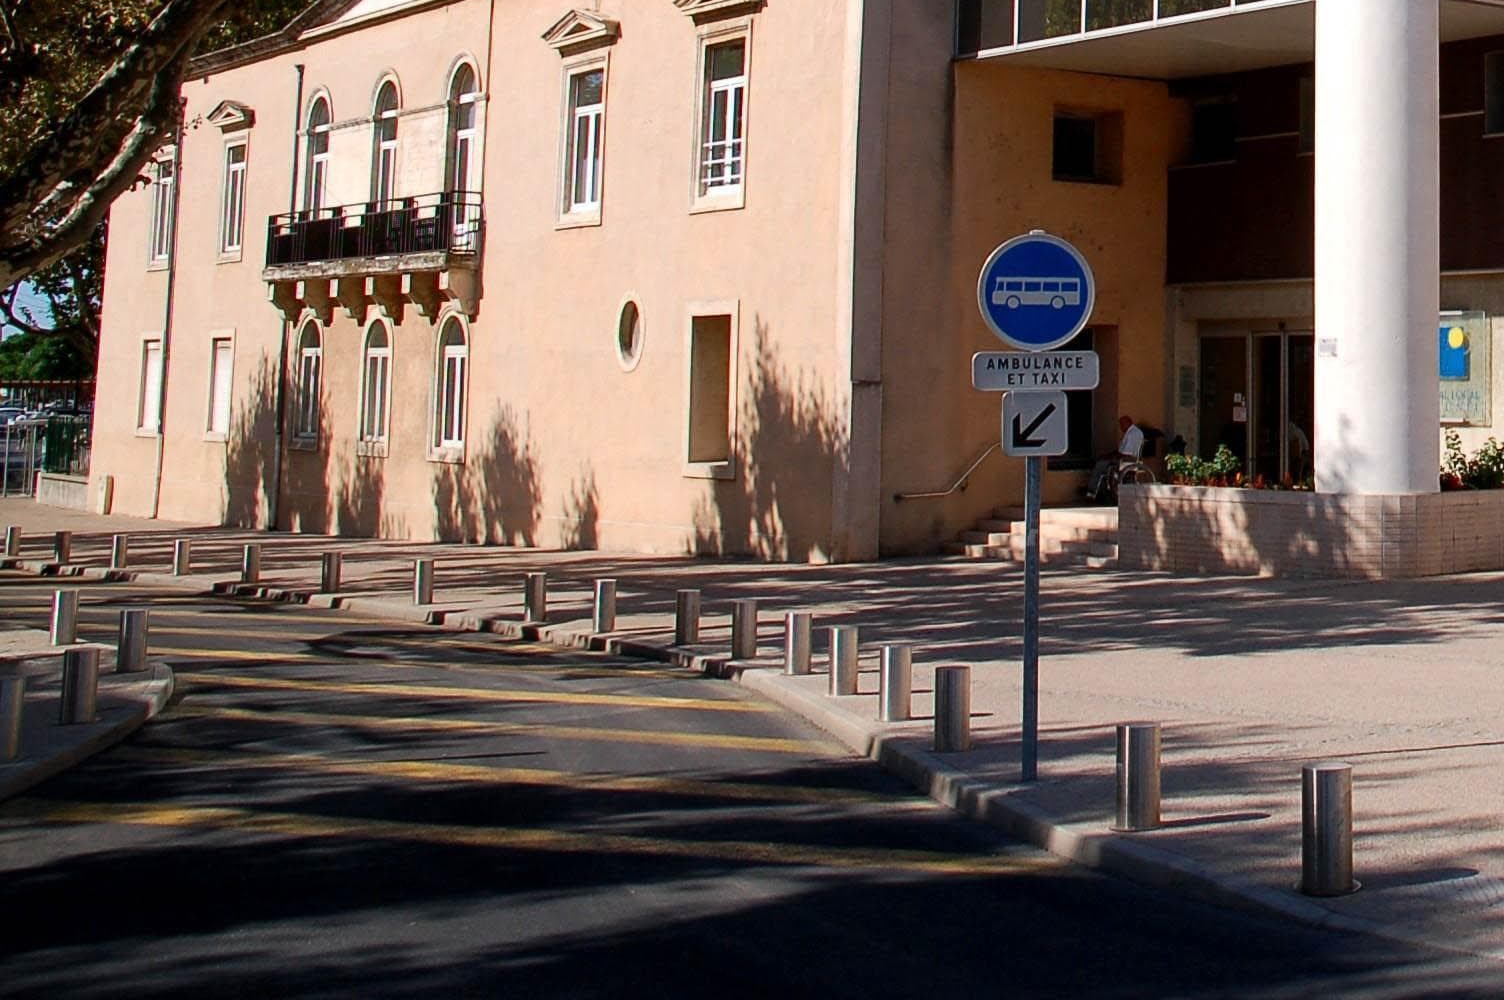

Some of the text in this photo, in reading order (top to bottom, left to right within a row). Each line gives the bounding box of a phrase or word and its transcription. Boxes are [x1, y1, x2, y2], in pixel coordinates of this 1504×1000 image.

[986, 357, 1084, 370] AMBULANCE
[1007, 372, 1065, 385] ET TAXI
